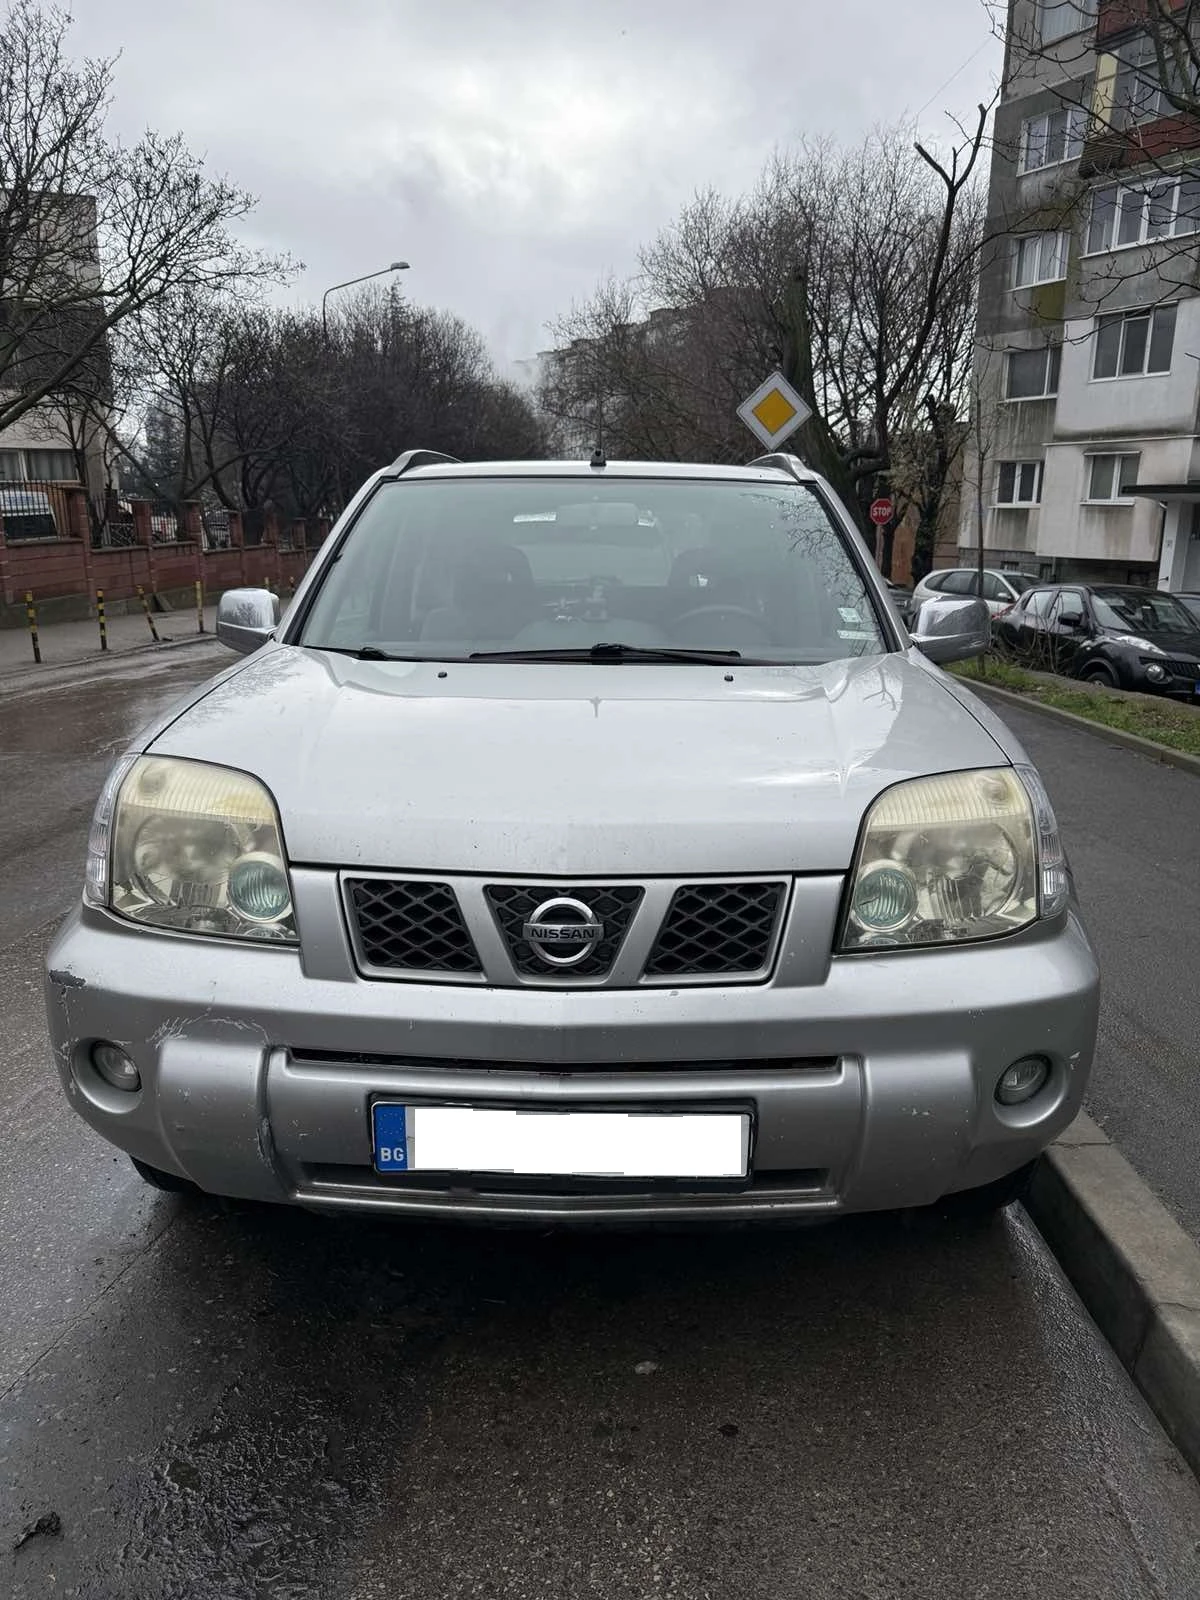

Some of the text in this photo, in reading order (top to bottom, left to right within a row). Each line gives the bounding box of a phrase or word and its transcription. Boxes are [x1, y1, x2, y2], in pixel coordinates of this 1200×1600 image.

[872, 506, 891, 516] STOP
[531, 928, 594, 939] NISSAN
[380, 1147, 404, 1162] BG
